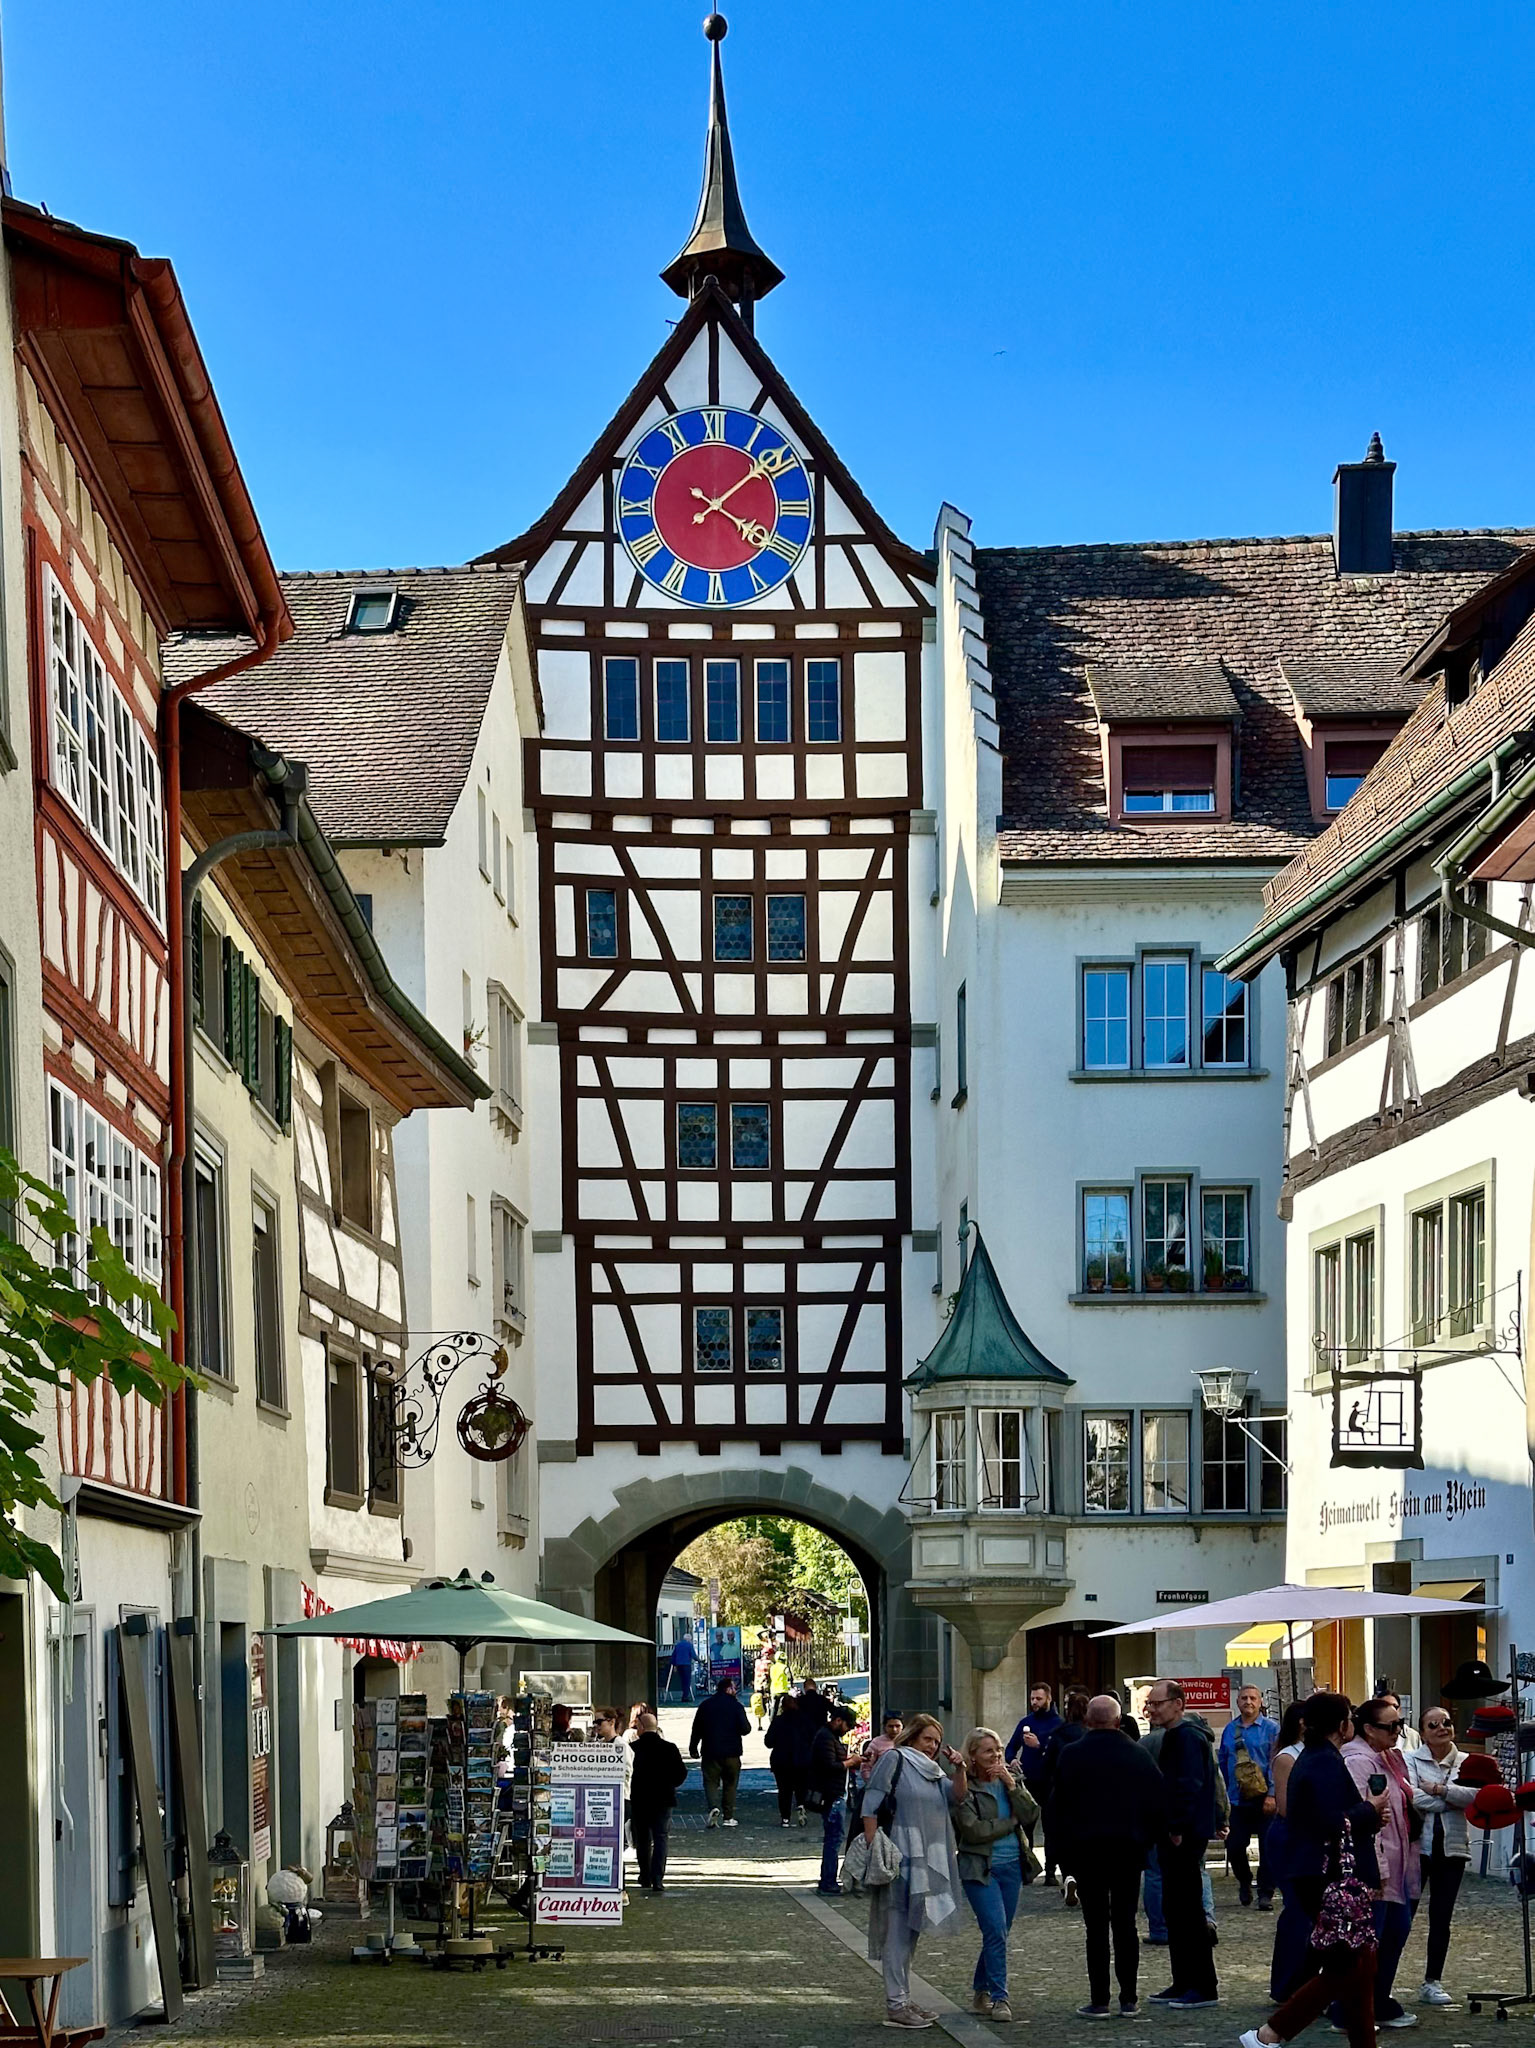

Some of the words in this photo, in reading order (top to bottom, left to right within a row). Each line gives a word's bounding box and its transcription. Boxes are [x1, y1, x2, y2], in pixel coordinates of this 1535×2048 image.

[657, 419, 690, 454] XI
[700, 410, 728, 442] XII
[744, 422, 764, 452] I
[630, 452, 662, 480] X
[620, 496, 651, 518] IX
[779, 498, 810, 518] III
[628, 529, 663, 568] VIII
[767, 531, 802, 566] IIII
[659, 558, 688, 595] VII
[706, 572, 728, 603] VI
[747, 564, 770, 594] V
[1319, 1496, 1381, 1535] Heimatwelt
[1388, 1490, 1421, 1527] Stein
[1424, 1493, 1442, 1515] am
[1446, 1480, 1486, 1522] Rhein
[1180, 1680, 1213, 1689] chweizer
[1185, 1690, 1218, 1700] uvenir
[552, 1754, 624, 1763] CHOGGIBOX
[538, 1896, 621, 1916] Candybox
